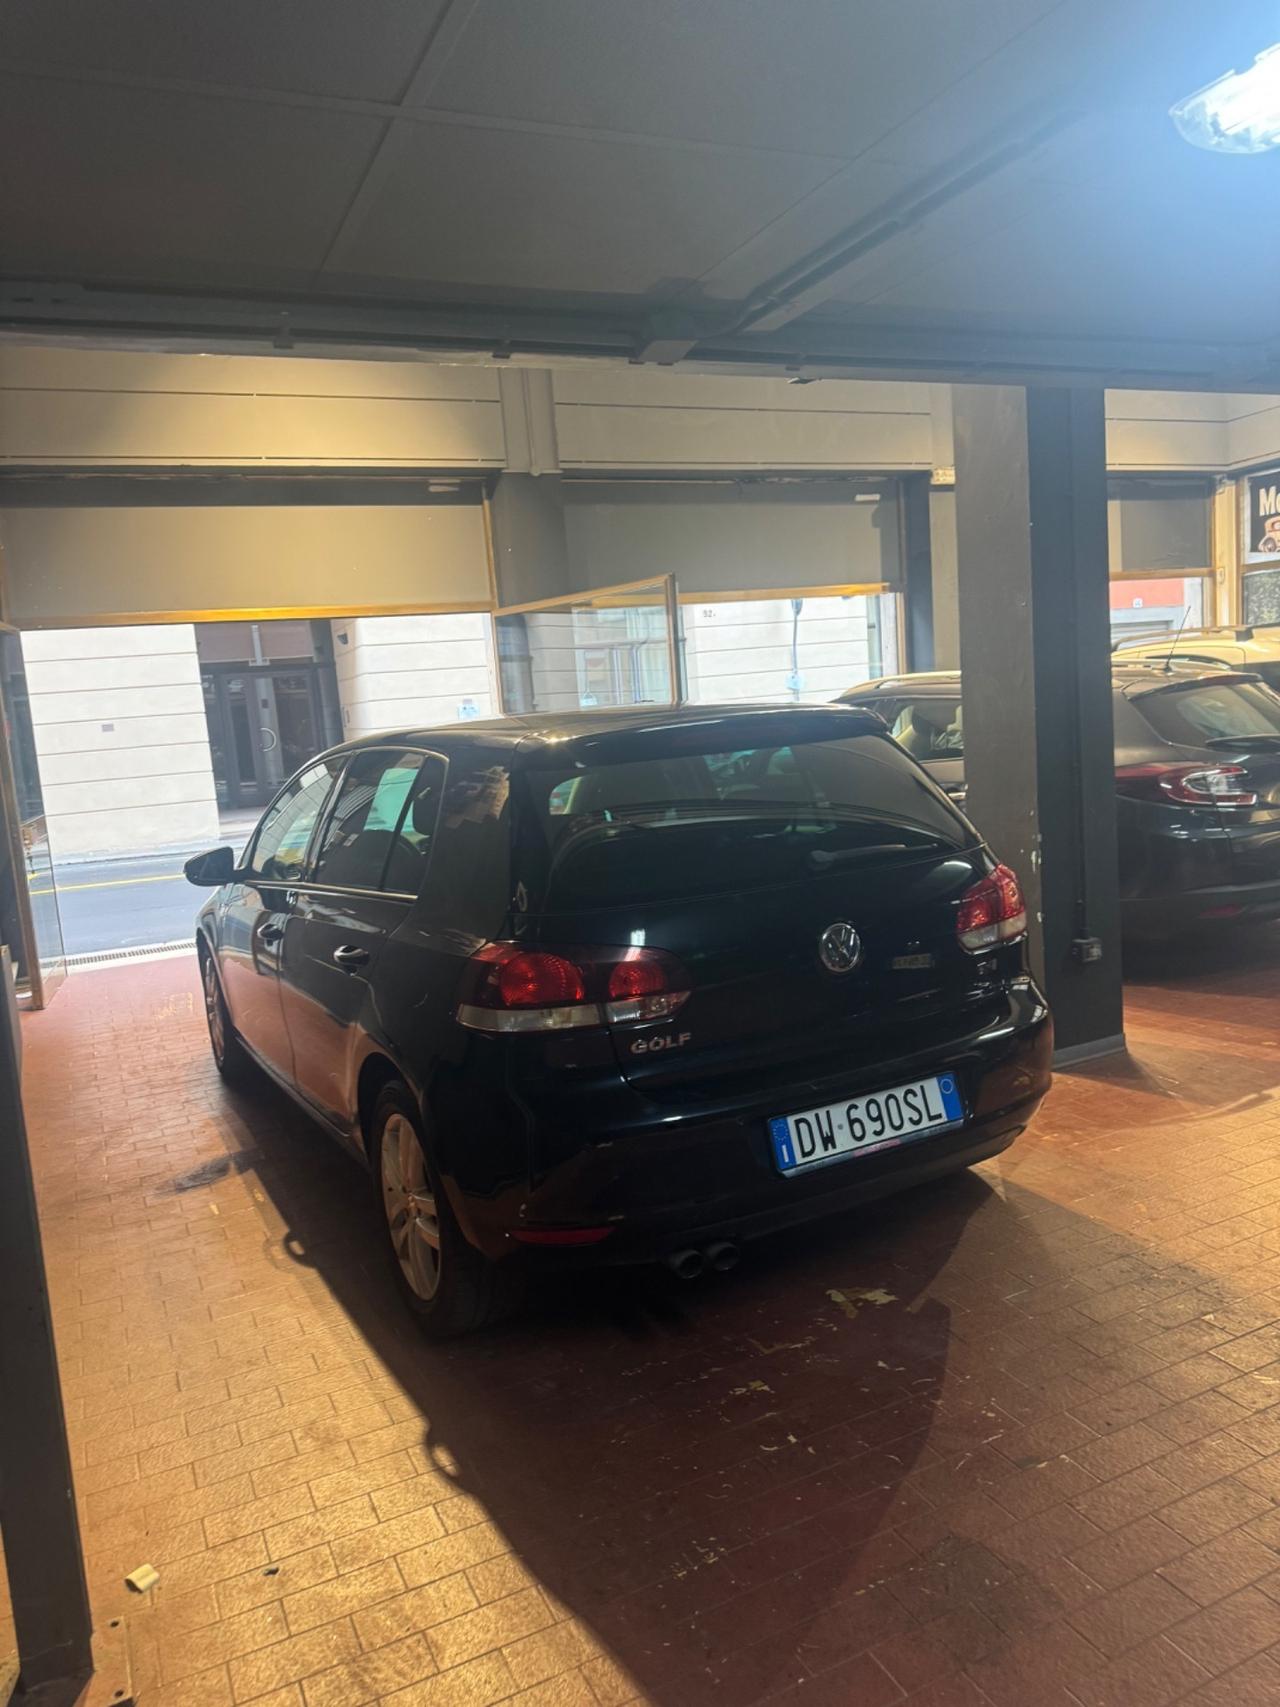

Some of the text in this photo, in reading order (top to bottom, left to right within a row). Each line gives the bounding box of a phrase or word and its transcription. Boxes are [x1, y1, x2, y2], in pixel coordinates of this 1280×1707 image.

[630, 1032, 691, 1054] GOLF
[793, 1109, 837, 1158] DW
[846, 1084, 943, 1142] 690SL
